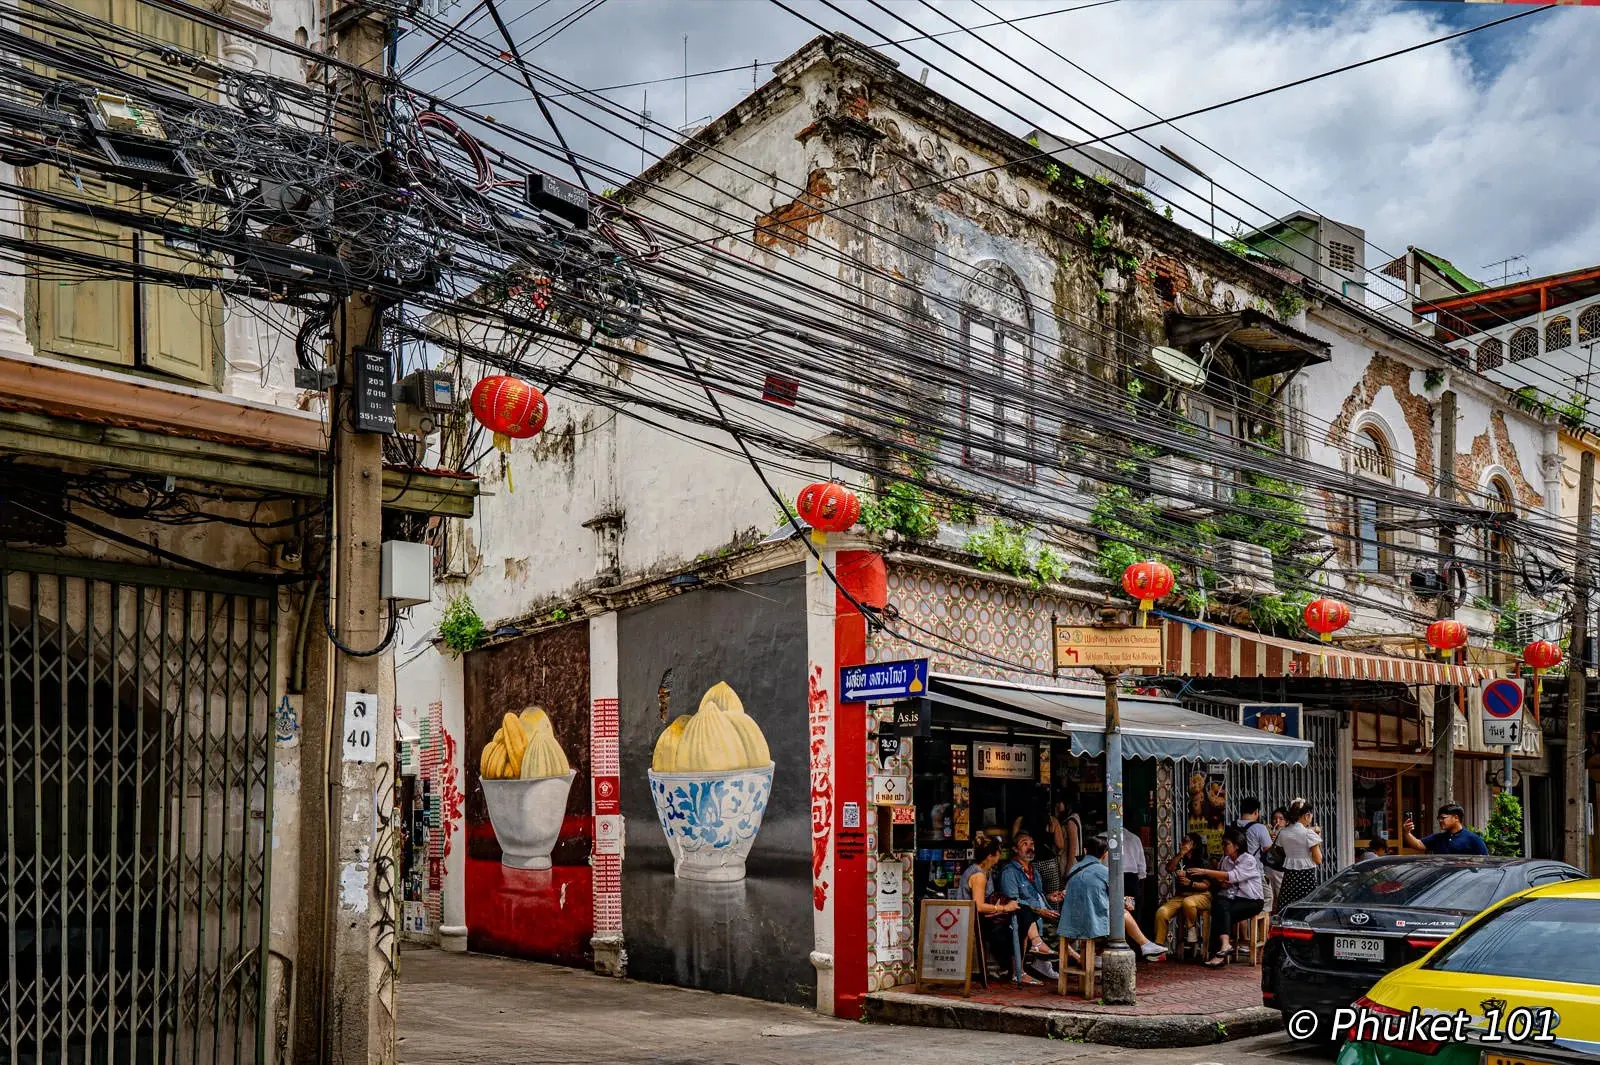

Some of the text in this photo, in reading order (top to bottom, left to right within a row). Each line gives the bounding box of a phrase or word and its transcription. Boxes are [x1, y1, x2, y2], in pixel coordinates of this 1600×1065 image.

[366, 364, 385, 373] 0102
[368, 377, 384, 386] 203
[897, 710, 919, 723] As.is
[1488, 726, 1505, 738] วันคู่
[347, 729, 370, 748] 40
[1336, 939, 1379, 950] 8กค 320
